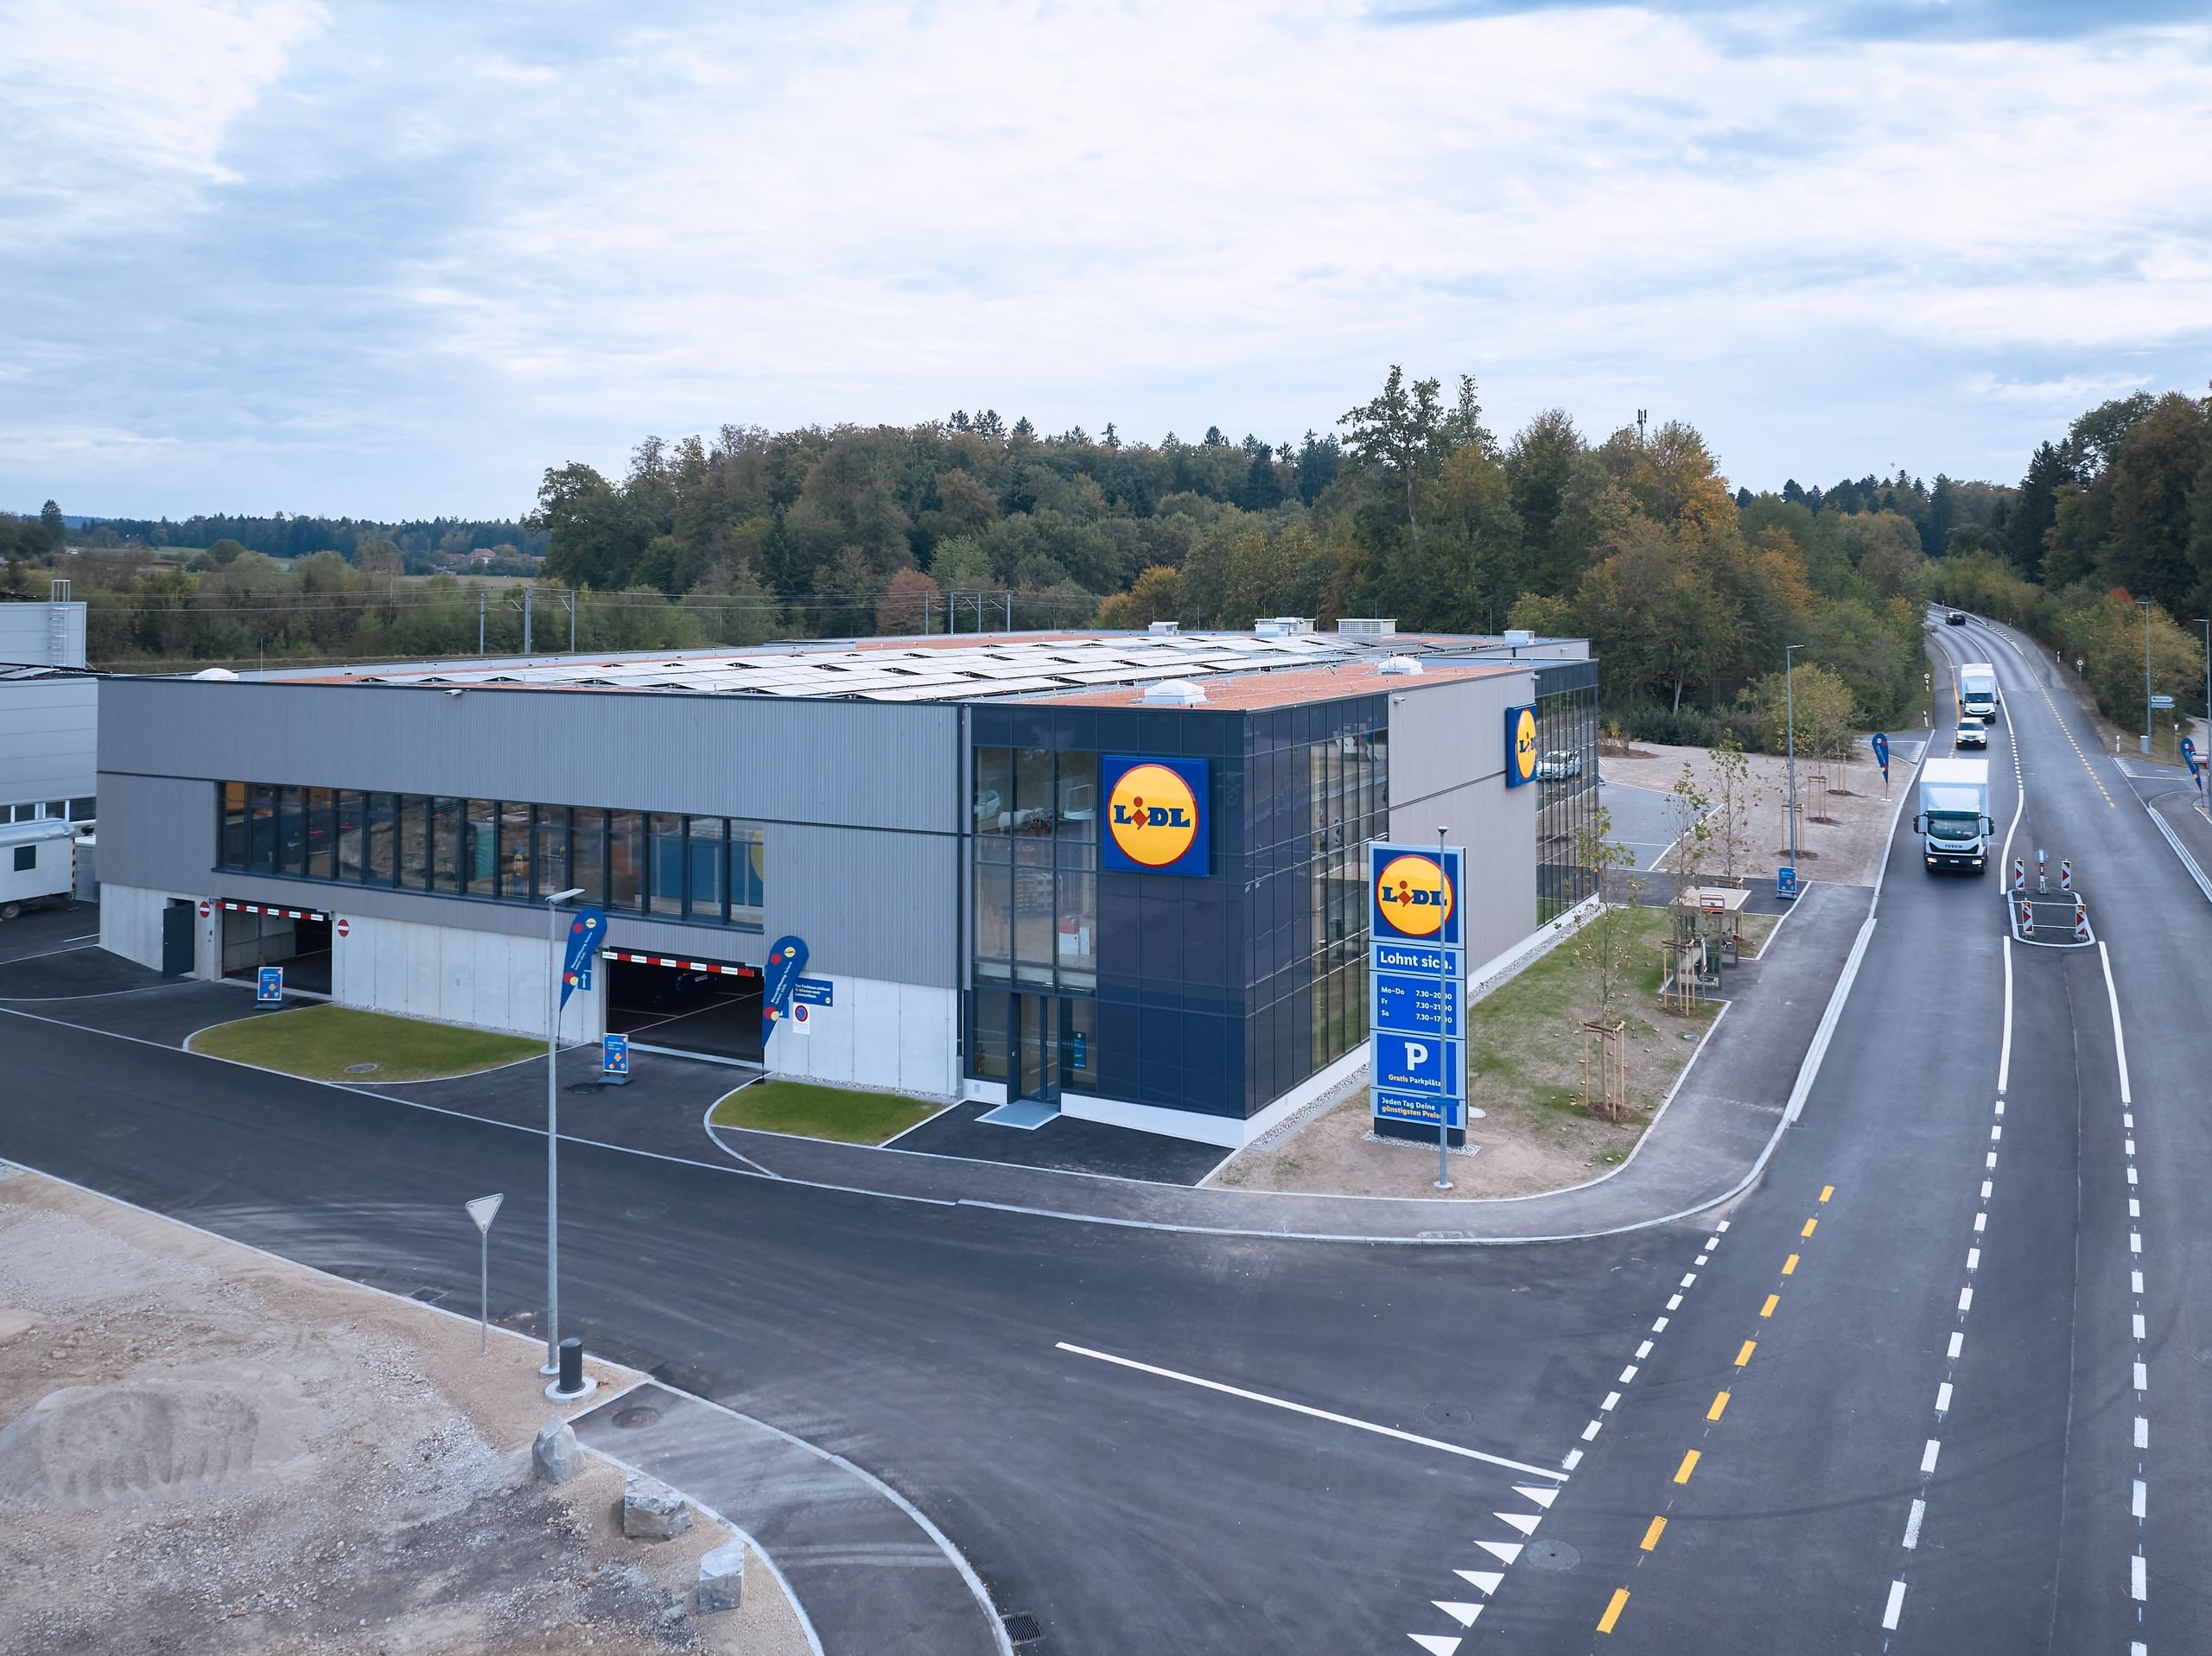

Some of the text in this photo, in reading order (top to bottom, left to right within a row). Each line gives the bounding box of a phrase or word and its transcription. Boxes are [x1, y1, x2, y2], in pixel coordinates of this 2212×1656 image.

[1381, 951, 1418, 966] Lohnt
[1404, 1042, 1428, 1071] P
[1389, 1074, 1441, 1087] Gratis Parkplätz
[1382, 1097, 1402, 1106] Jeden
[1402, 1100, 1414, 1109] Tag
[1415, 1101, 1435, 1111] Deine
[1382, 1105, 1441, 1119] günstigsten Preis
